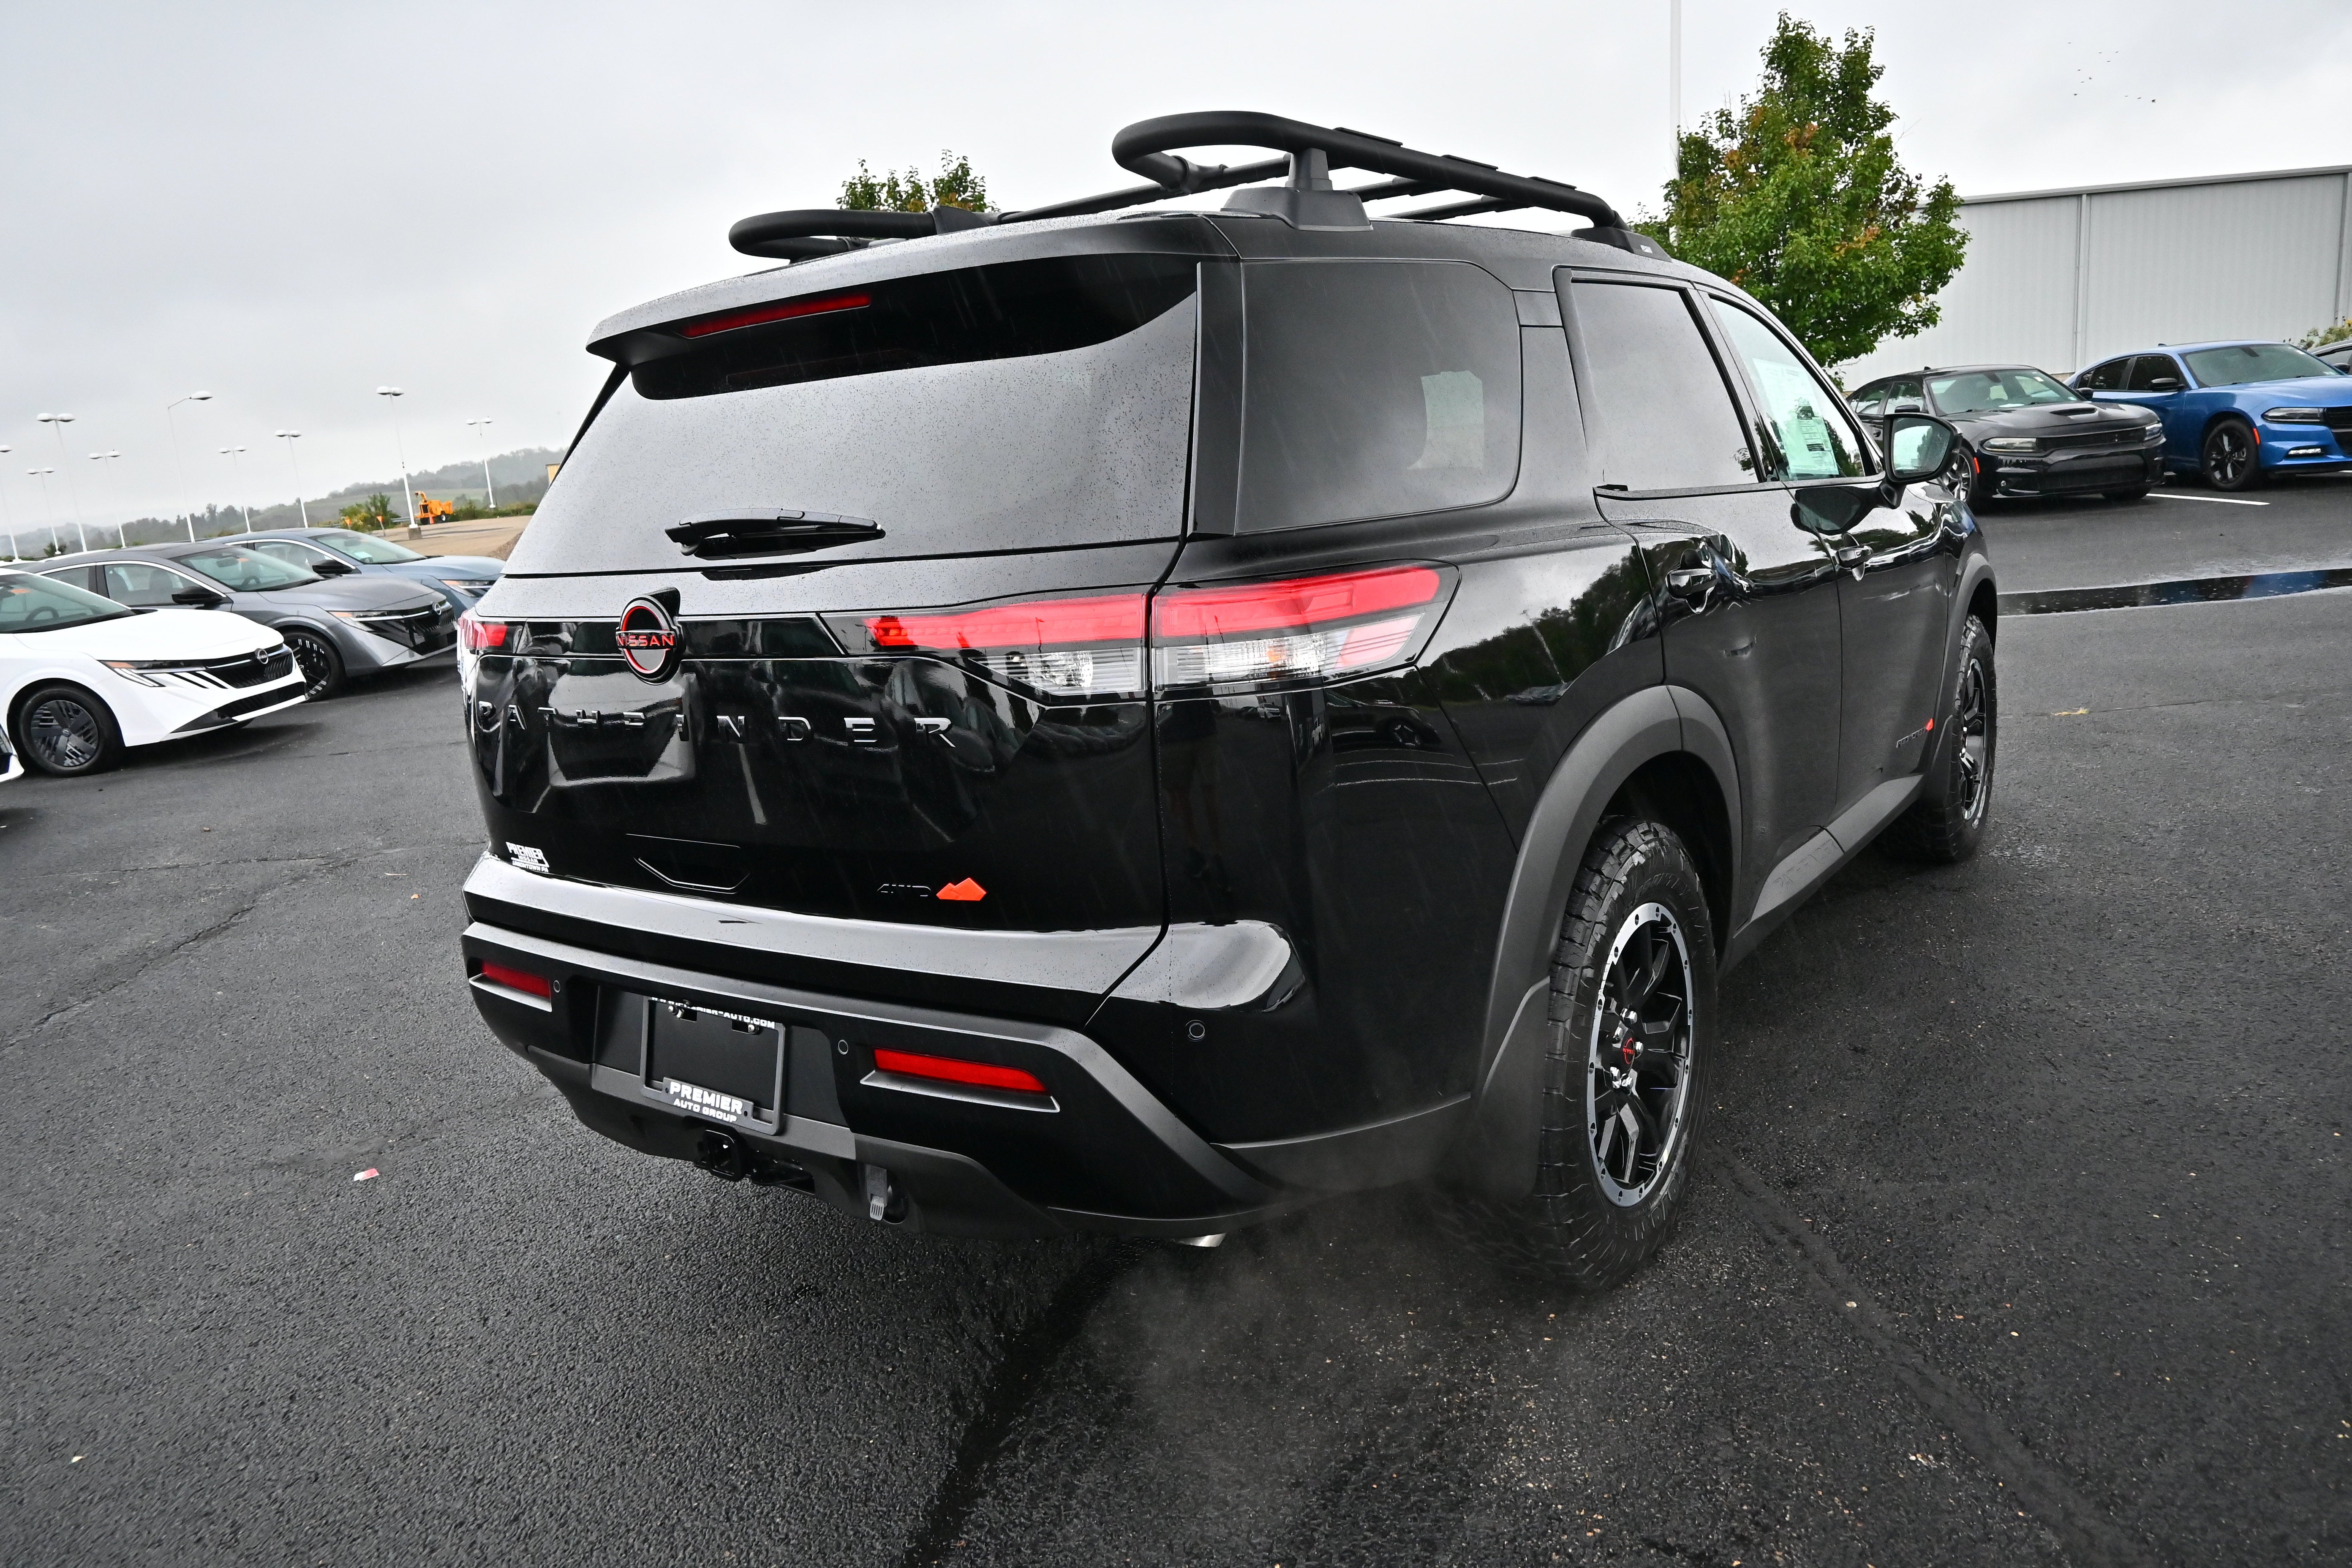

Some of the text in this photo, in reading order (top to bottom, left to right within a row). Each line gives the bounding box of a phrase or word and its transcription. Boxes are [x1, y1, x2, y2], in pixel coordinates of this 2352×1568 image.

[617, 634, 675, 647] NISSAN
[478, 700, 957, 749] PATHFINDER
[506, 841, 544, 860] PREMIER
[670, 1081, 743, 1115] PREMIER
[673, 1098, 737, 1123] AUTO GROUP
